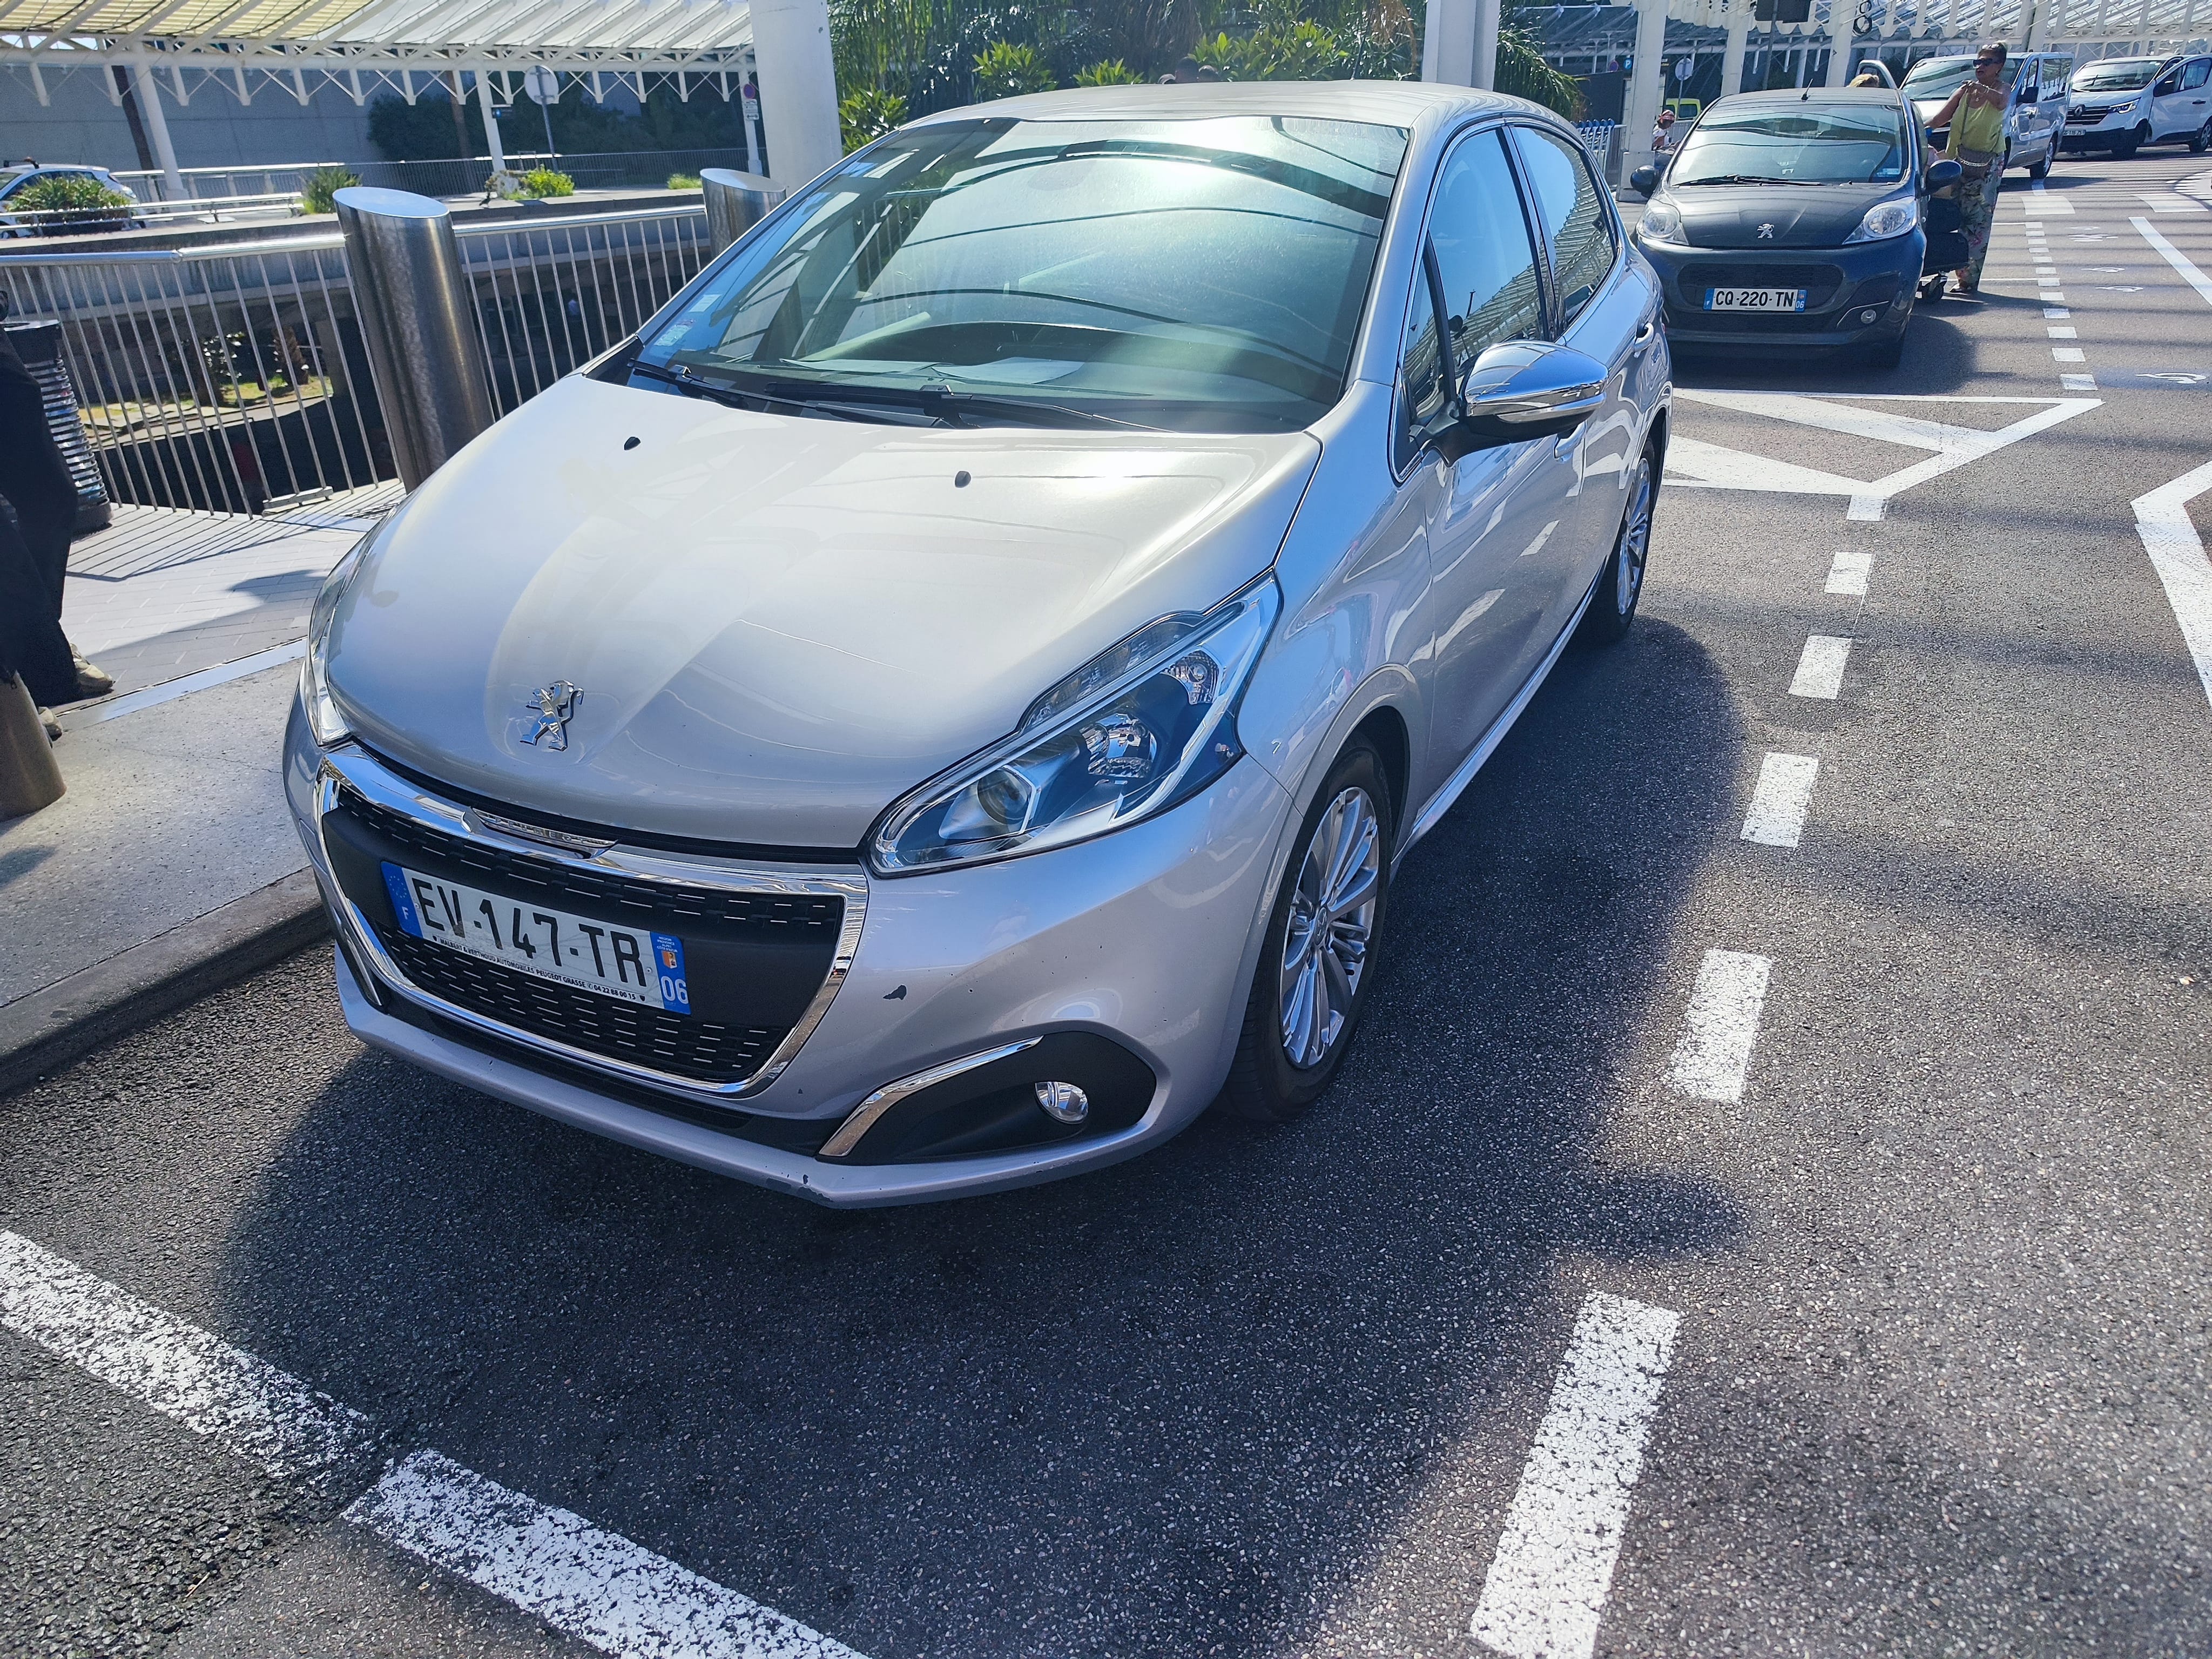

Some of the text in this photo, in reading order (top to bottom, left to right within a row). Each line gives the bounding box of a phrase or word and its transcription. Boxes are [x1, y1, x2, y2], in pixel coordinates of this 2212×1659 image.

[1716, 291, 1794, 307] CQ-220-TN
[495, 816, 585, 844] PEUGEOT
[401, 907, 409, 919] F
[411, 878, 647, 988] EV-147-TR
[497, 957, 534, 973] AUTOMOBILES
[536, 969, 563, 982] PEUGEOT
[563, 977, 586, 988] GRASSE
[661, 976, 689, 1004] 06
